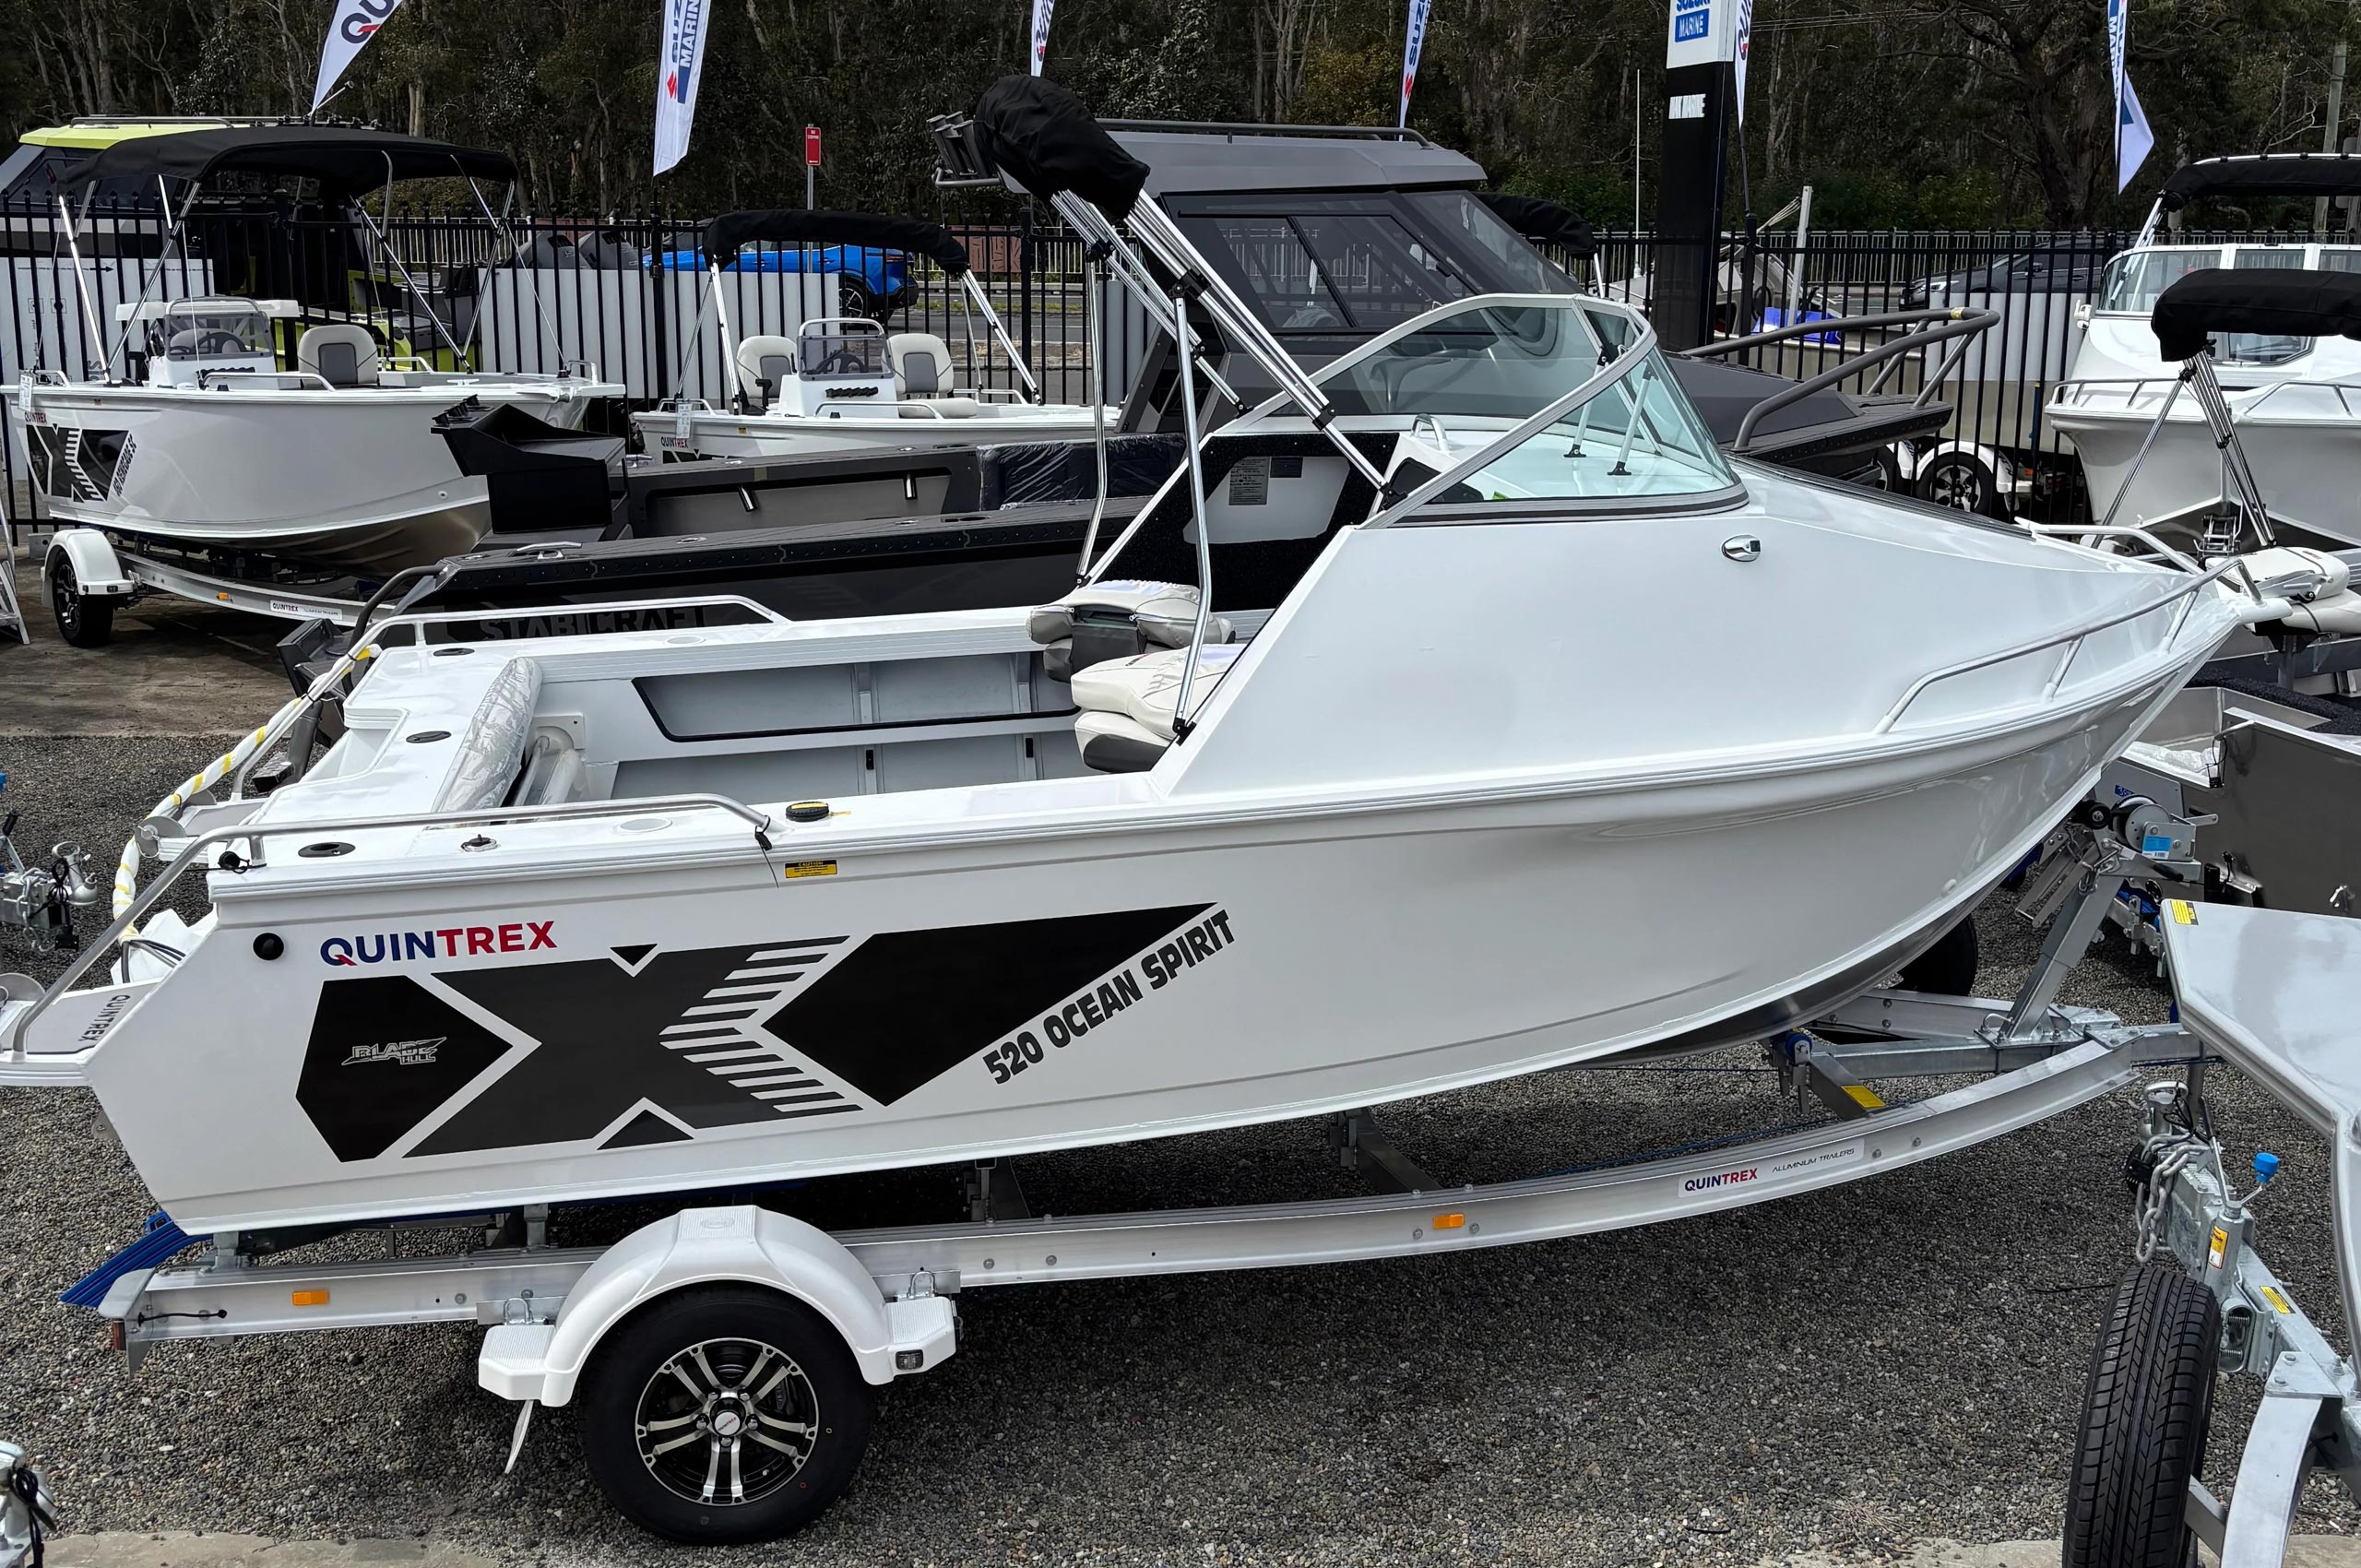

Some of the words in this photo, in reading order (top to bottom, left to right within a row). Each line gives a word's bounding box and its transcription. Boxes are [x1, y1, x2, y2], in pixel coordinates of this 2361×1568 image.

[1409, 0, 1426, 66] SUZ
[1679, 15, 1704, 38] MARINE
[661, 436, 688, 448] QUINTREX
[272, 602, 299, 612] QUINTREX
[479, 605, 706, 641] STABICRAFT
[320, 921, 558, 967] QUINTREX
[983, 1031, 1044, 1084] 520
[1043, 969, 1144, 1048] OCEAN
[1141, 909, 1235, 990] SPIRIT
[77, 995, 131, 1041] QUINTREX
[349, 1039, 445, 1061] BLADE
[400, 1053, 436, 1064] HULL
[1684, 1168, 1758, 1191] QUINTREX
[1772, 1158, 1817, 1172] ALUMINIUM
[1819, 1148, 1855, 1162] TRAILERS
